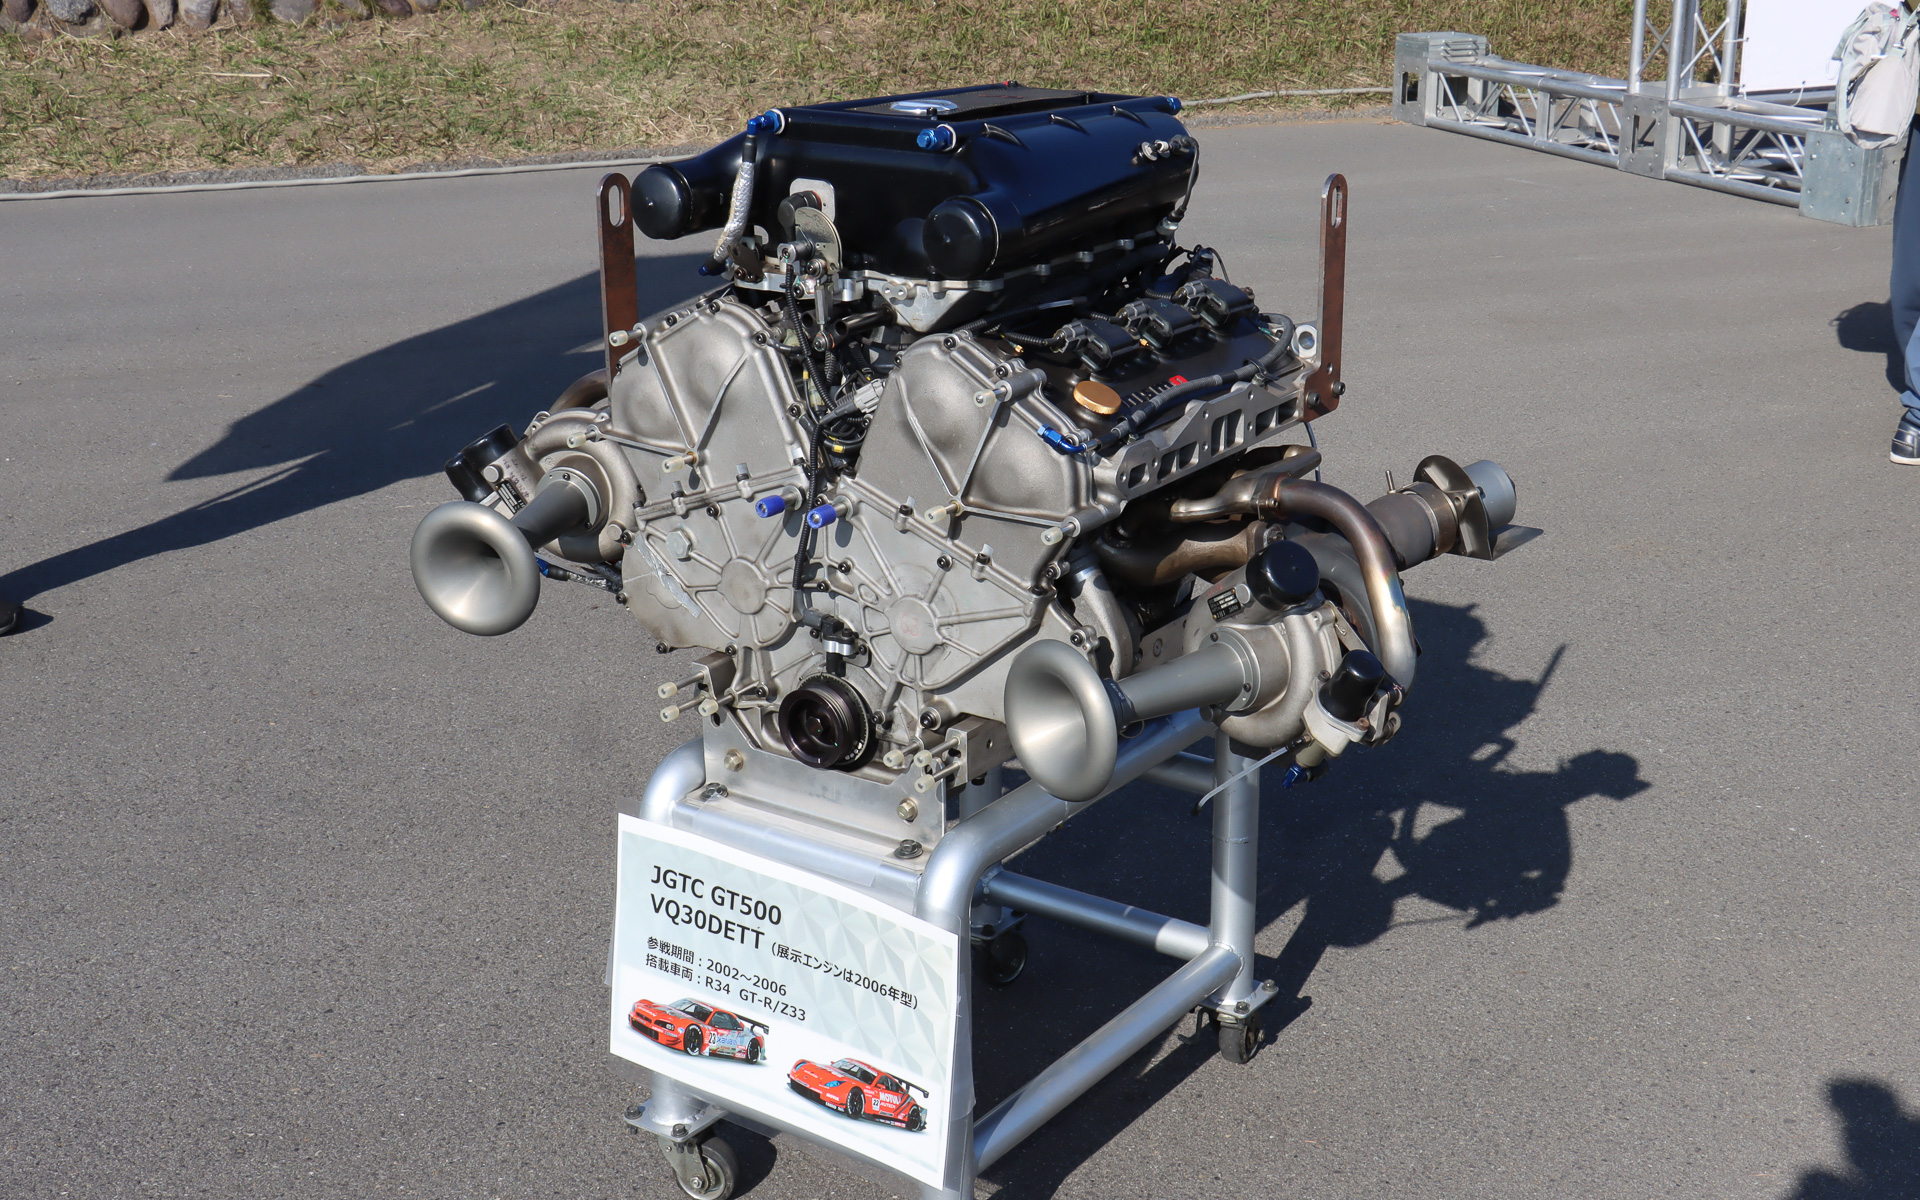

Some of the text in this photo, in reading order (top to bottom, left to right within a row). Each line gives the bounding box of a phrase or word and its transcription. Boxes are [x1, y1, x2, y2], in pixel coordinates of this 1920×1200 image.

[650, 865, 782, 926] JGTC GT500
[650, 893, 766, 950] VQ30DETT
[739, 988, 807, 1021] GT-R/Z33
